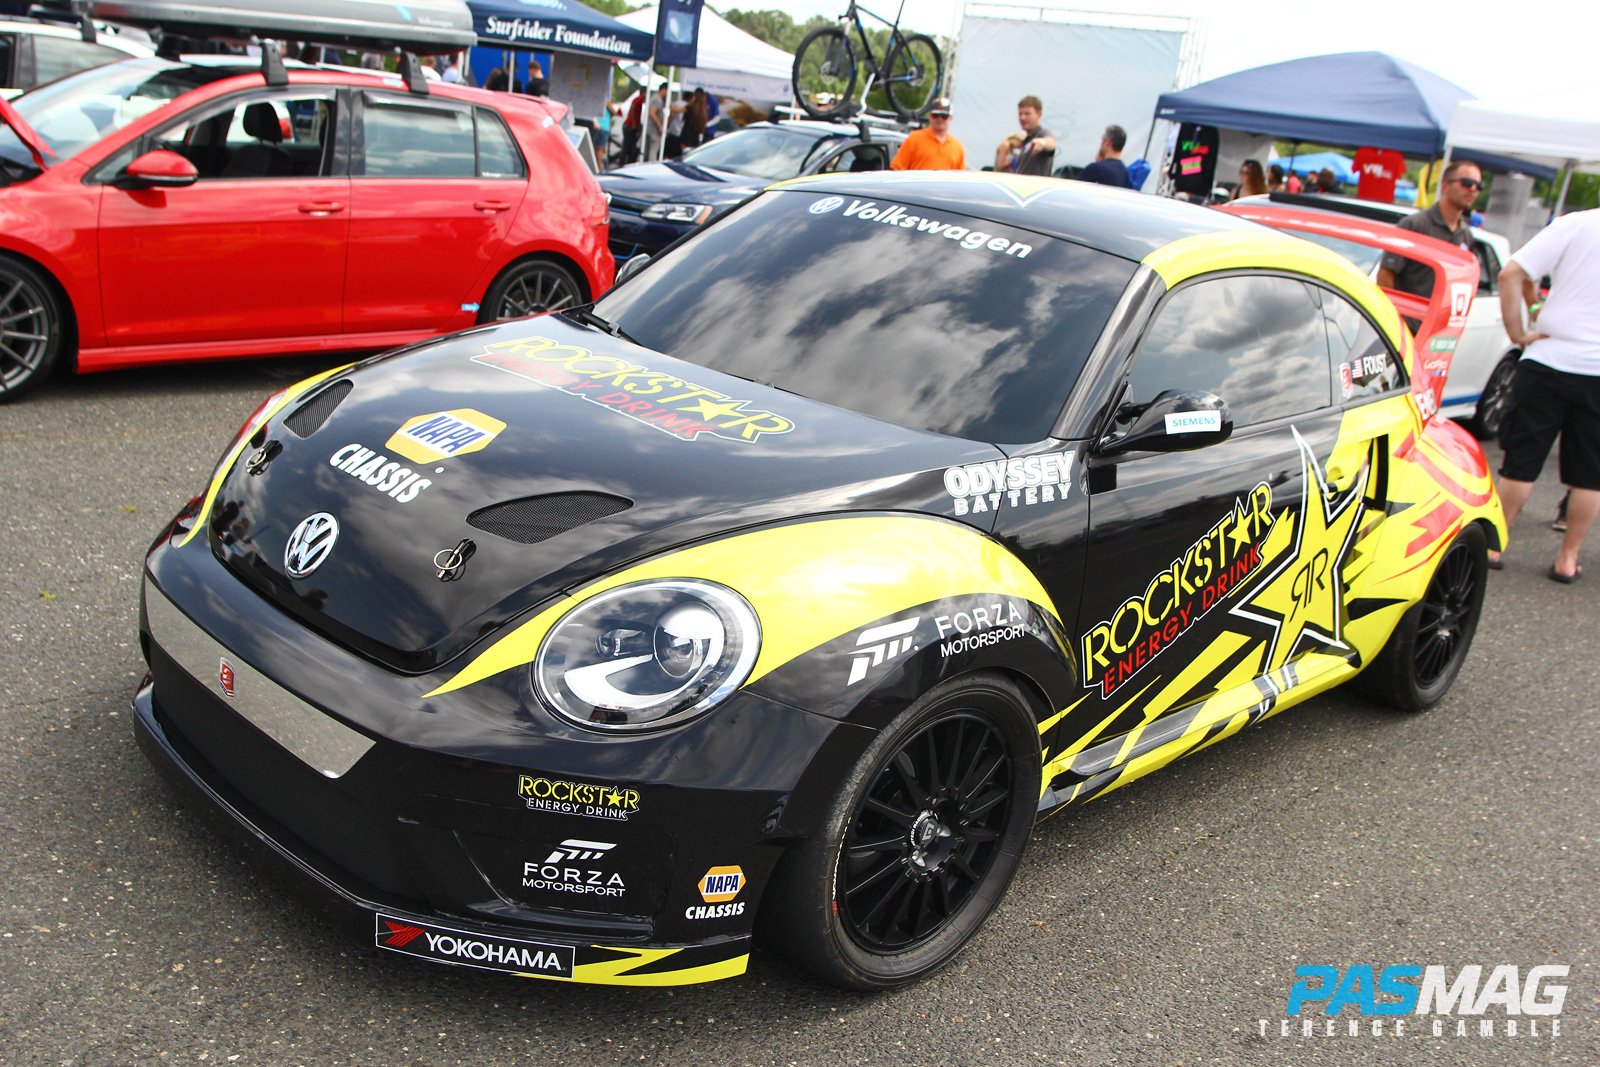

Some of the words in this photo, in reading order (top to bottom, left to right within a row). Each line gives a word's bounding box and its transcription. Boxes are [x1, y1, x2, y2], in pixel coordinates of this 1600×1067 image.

[486, 15, 553, 41] Surfrider
[555, 24, 632, 54] Foundation
[843, 200, 1033, 259] Volkswagen
[1362, 353, 1386, 376] FOUST
[480, 353, 602, 391] ENERGY
[596, 392, 714, 437] DRINK
[406, 415, 486, 453] NAPA
[1172, 416, 1216, 427] SIEMENS
[329, 443, 432, 503] CHASSIS
[944, 451, 1075, 498] ODYSSEY
[954, 482, 1072, 516] BATTERY
[934, 600, 1022, 639] FORZA
[1105, 601, 1192, 694] ENERGY
[1202, 541, 1262, 611] DRINK
[941, 624, 1026, 658] MOTORSPORT
[528, 798, 580, 814] ENERGY
[586, 805, 627, 819] DRINK
[522, 878, 626, 897] MOTORSPORT
[523, 862, 625, 887] FORZA
[705, 875, 739, 893] NAPA
[685, 902, 746, 920] CHASSIS
[425, 932, 562, 971] YOKOHAMA
